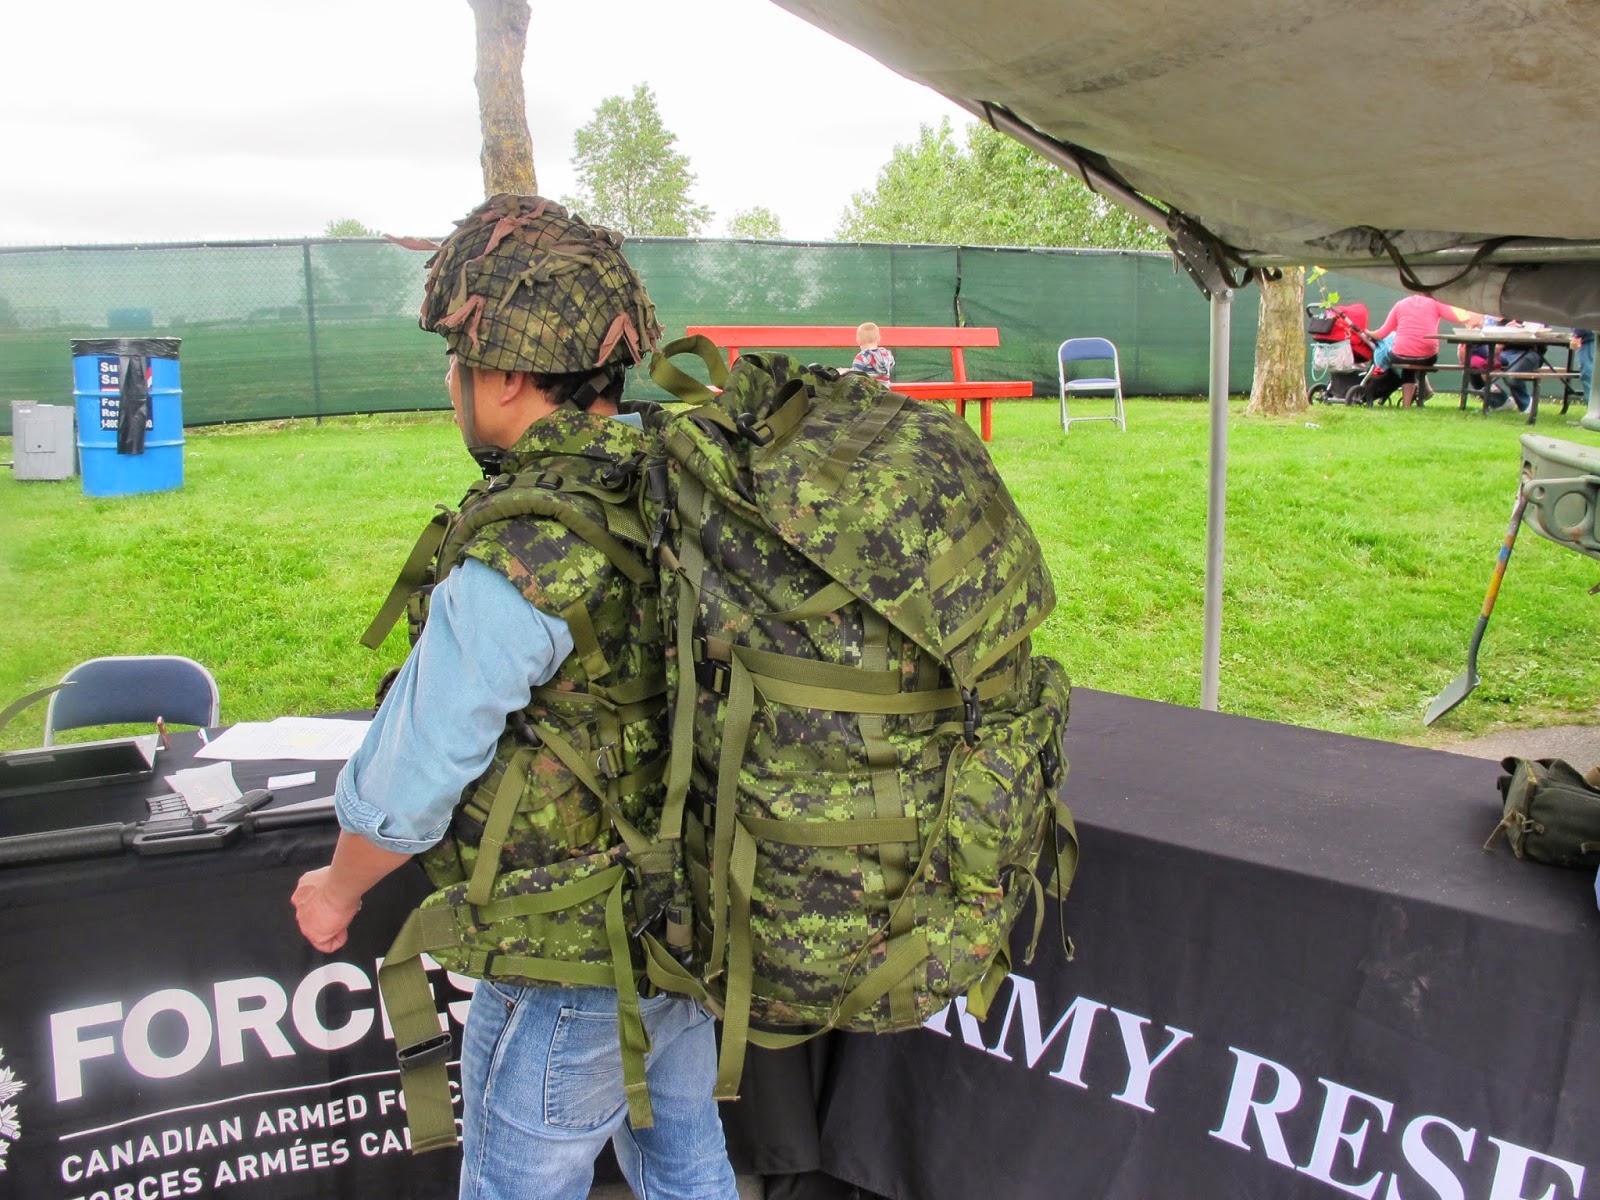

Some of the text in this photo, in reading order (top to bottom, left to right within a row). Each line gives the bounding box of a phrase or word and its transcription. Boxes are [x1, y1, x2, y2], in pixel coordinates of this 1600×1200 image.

[101, 362, 120, 373] Su
[102, 408, 119, 417] Re
[923, 972, 1194, 1113] MY
[61, 1116, 243, 1184] CANADIAN
[254, 1094, 368, 1139] ARMED
[70, 1167, 203, 1200] RCES
[214, 1138, 350, 1188] ARMÉES
